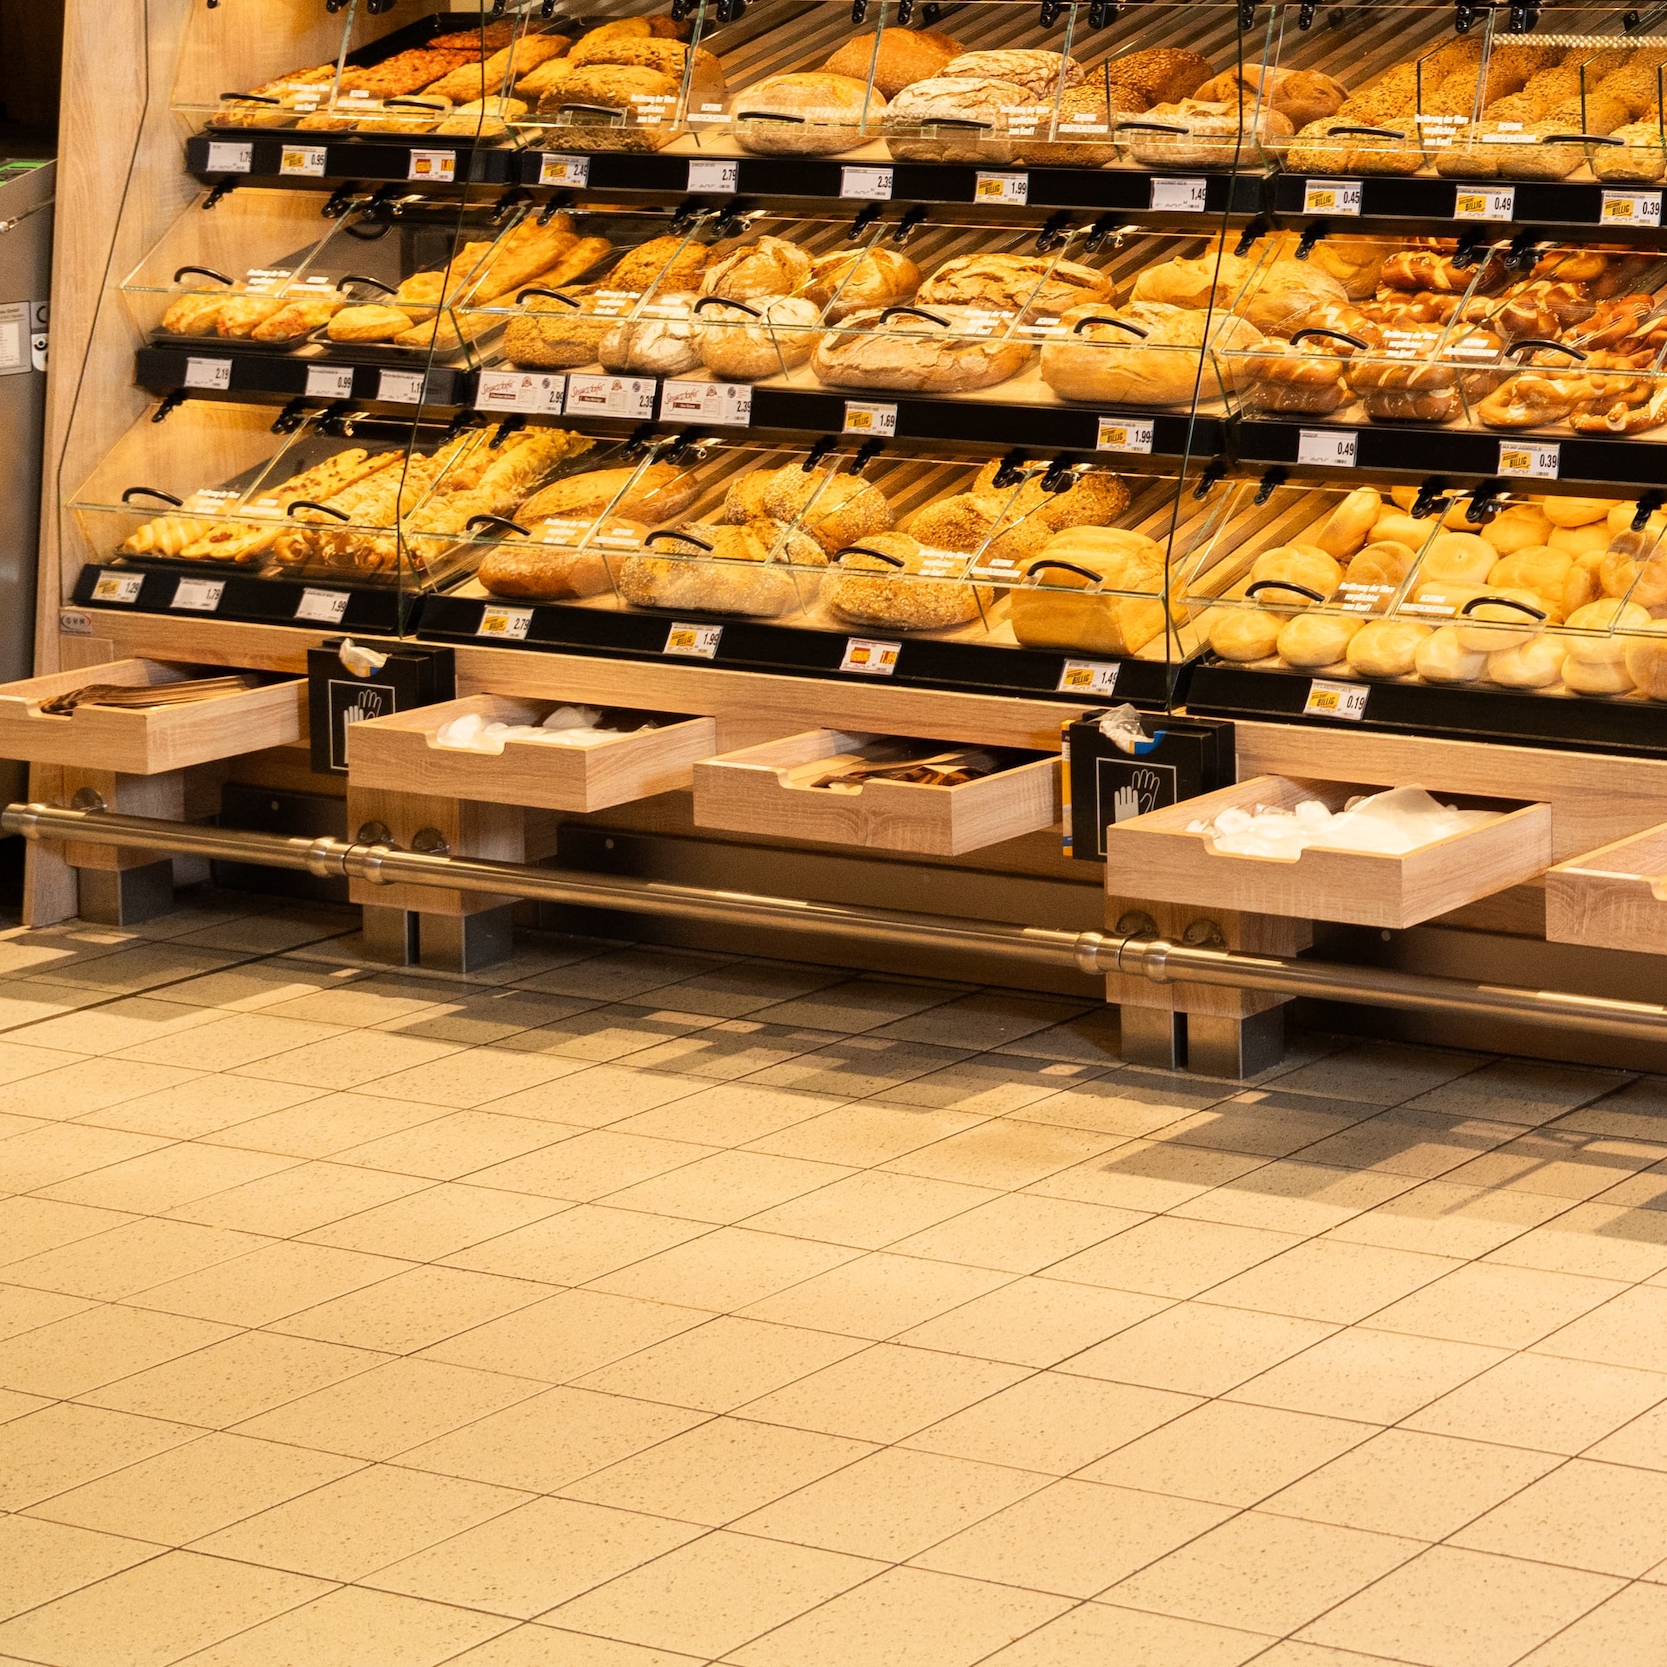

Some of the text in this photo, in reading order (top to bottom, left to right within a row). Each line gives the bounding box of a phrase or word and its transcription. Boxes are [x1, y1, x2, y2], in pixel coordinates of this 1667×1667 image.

[1010, 180, 1027, 194] 1.99
[1342, 190, 1360, 204] 0.45
[1494, 196, 1512, 212] 0.49
[1642, 198, 1660, 215] 0.39
[736, 400, 752, 413] 2.39
[879, 414, 896, 428] 1.69
[1337, 441, 1354, 457] 0.49
[1540, 454, 1558, 470] 0.39
[513, 617, 530, 631] 2.79
[702, 632, 718, 646] 1.99
[1100, 671, 1117, 684] 1.49
[1346, 696, 1365, 710] 0.19
